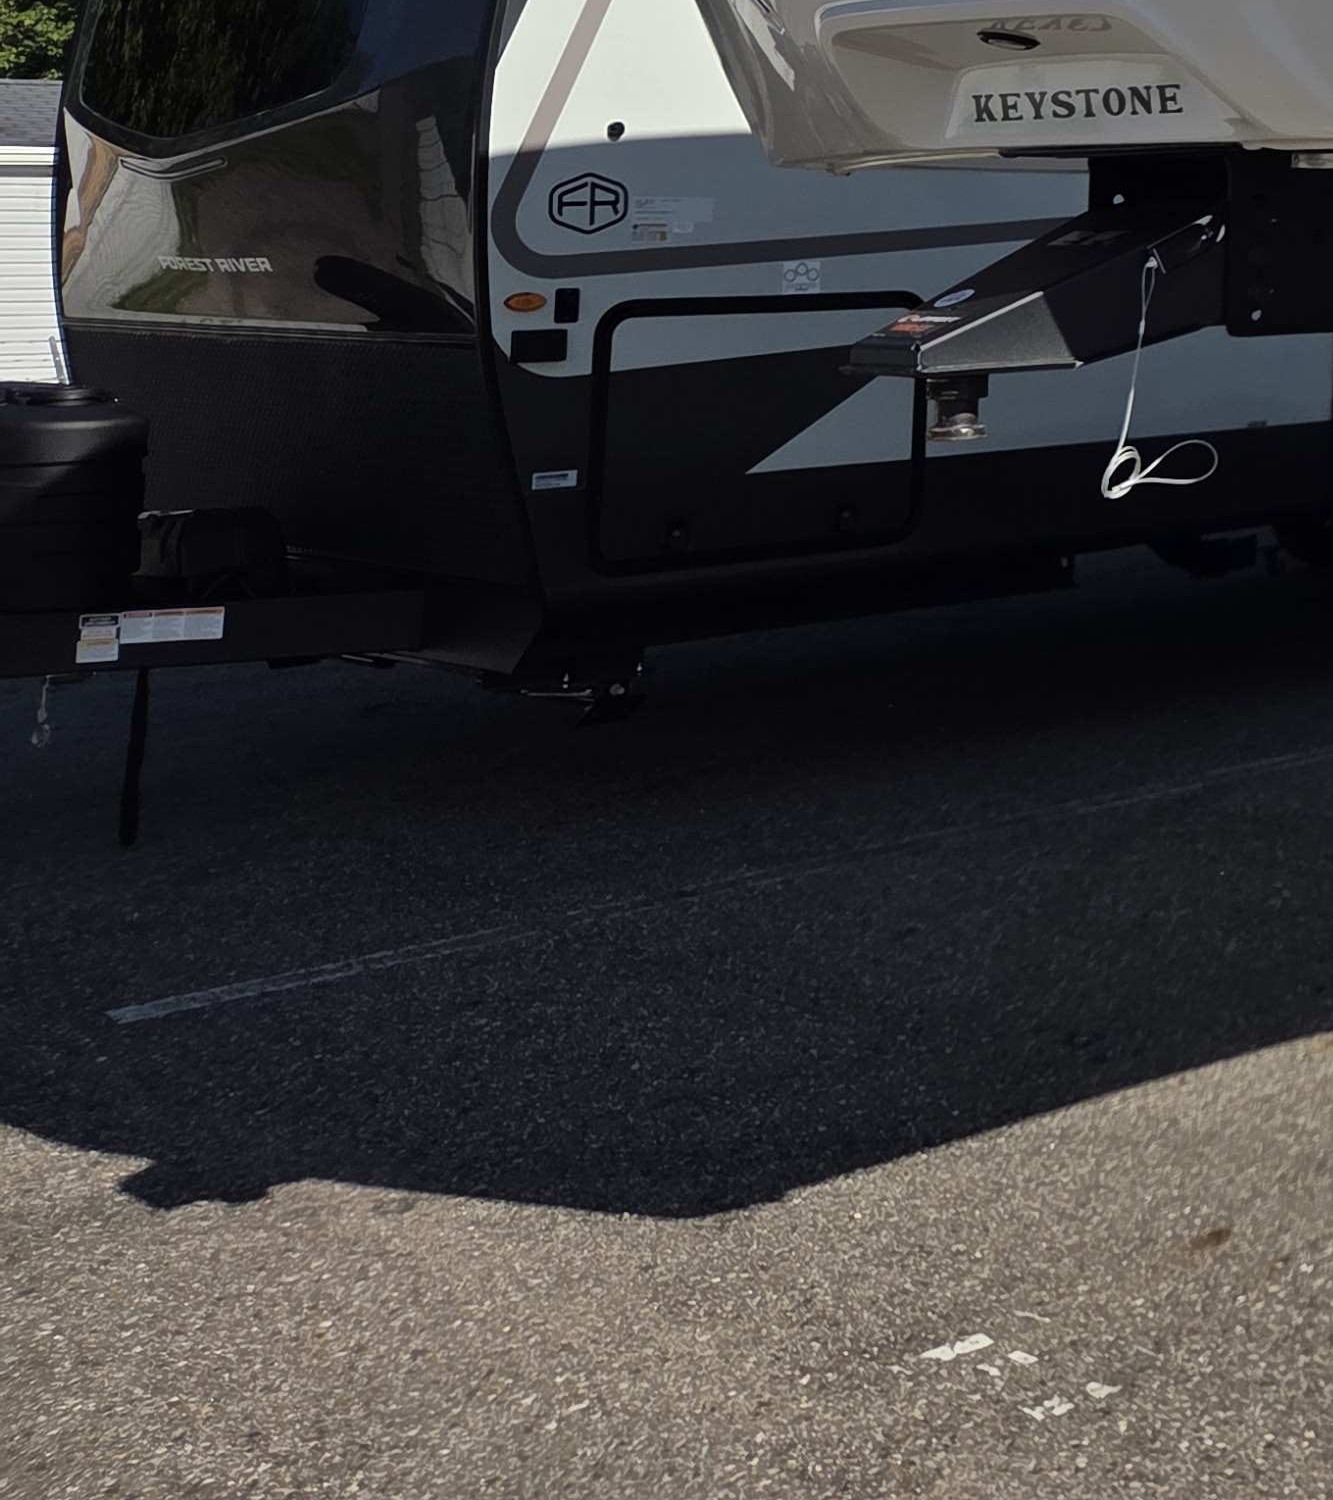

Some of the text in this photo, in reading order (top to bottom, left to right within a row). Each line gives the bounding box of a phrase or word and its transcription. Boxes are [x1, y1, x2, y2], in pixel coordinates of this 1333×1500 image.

[972, 84, 1183, 122] KEYSTONE
[557, 181, 620, 226] FR
[157, 255, 273, 273] FOREST RIVER
